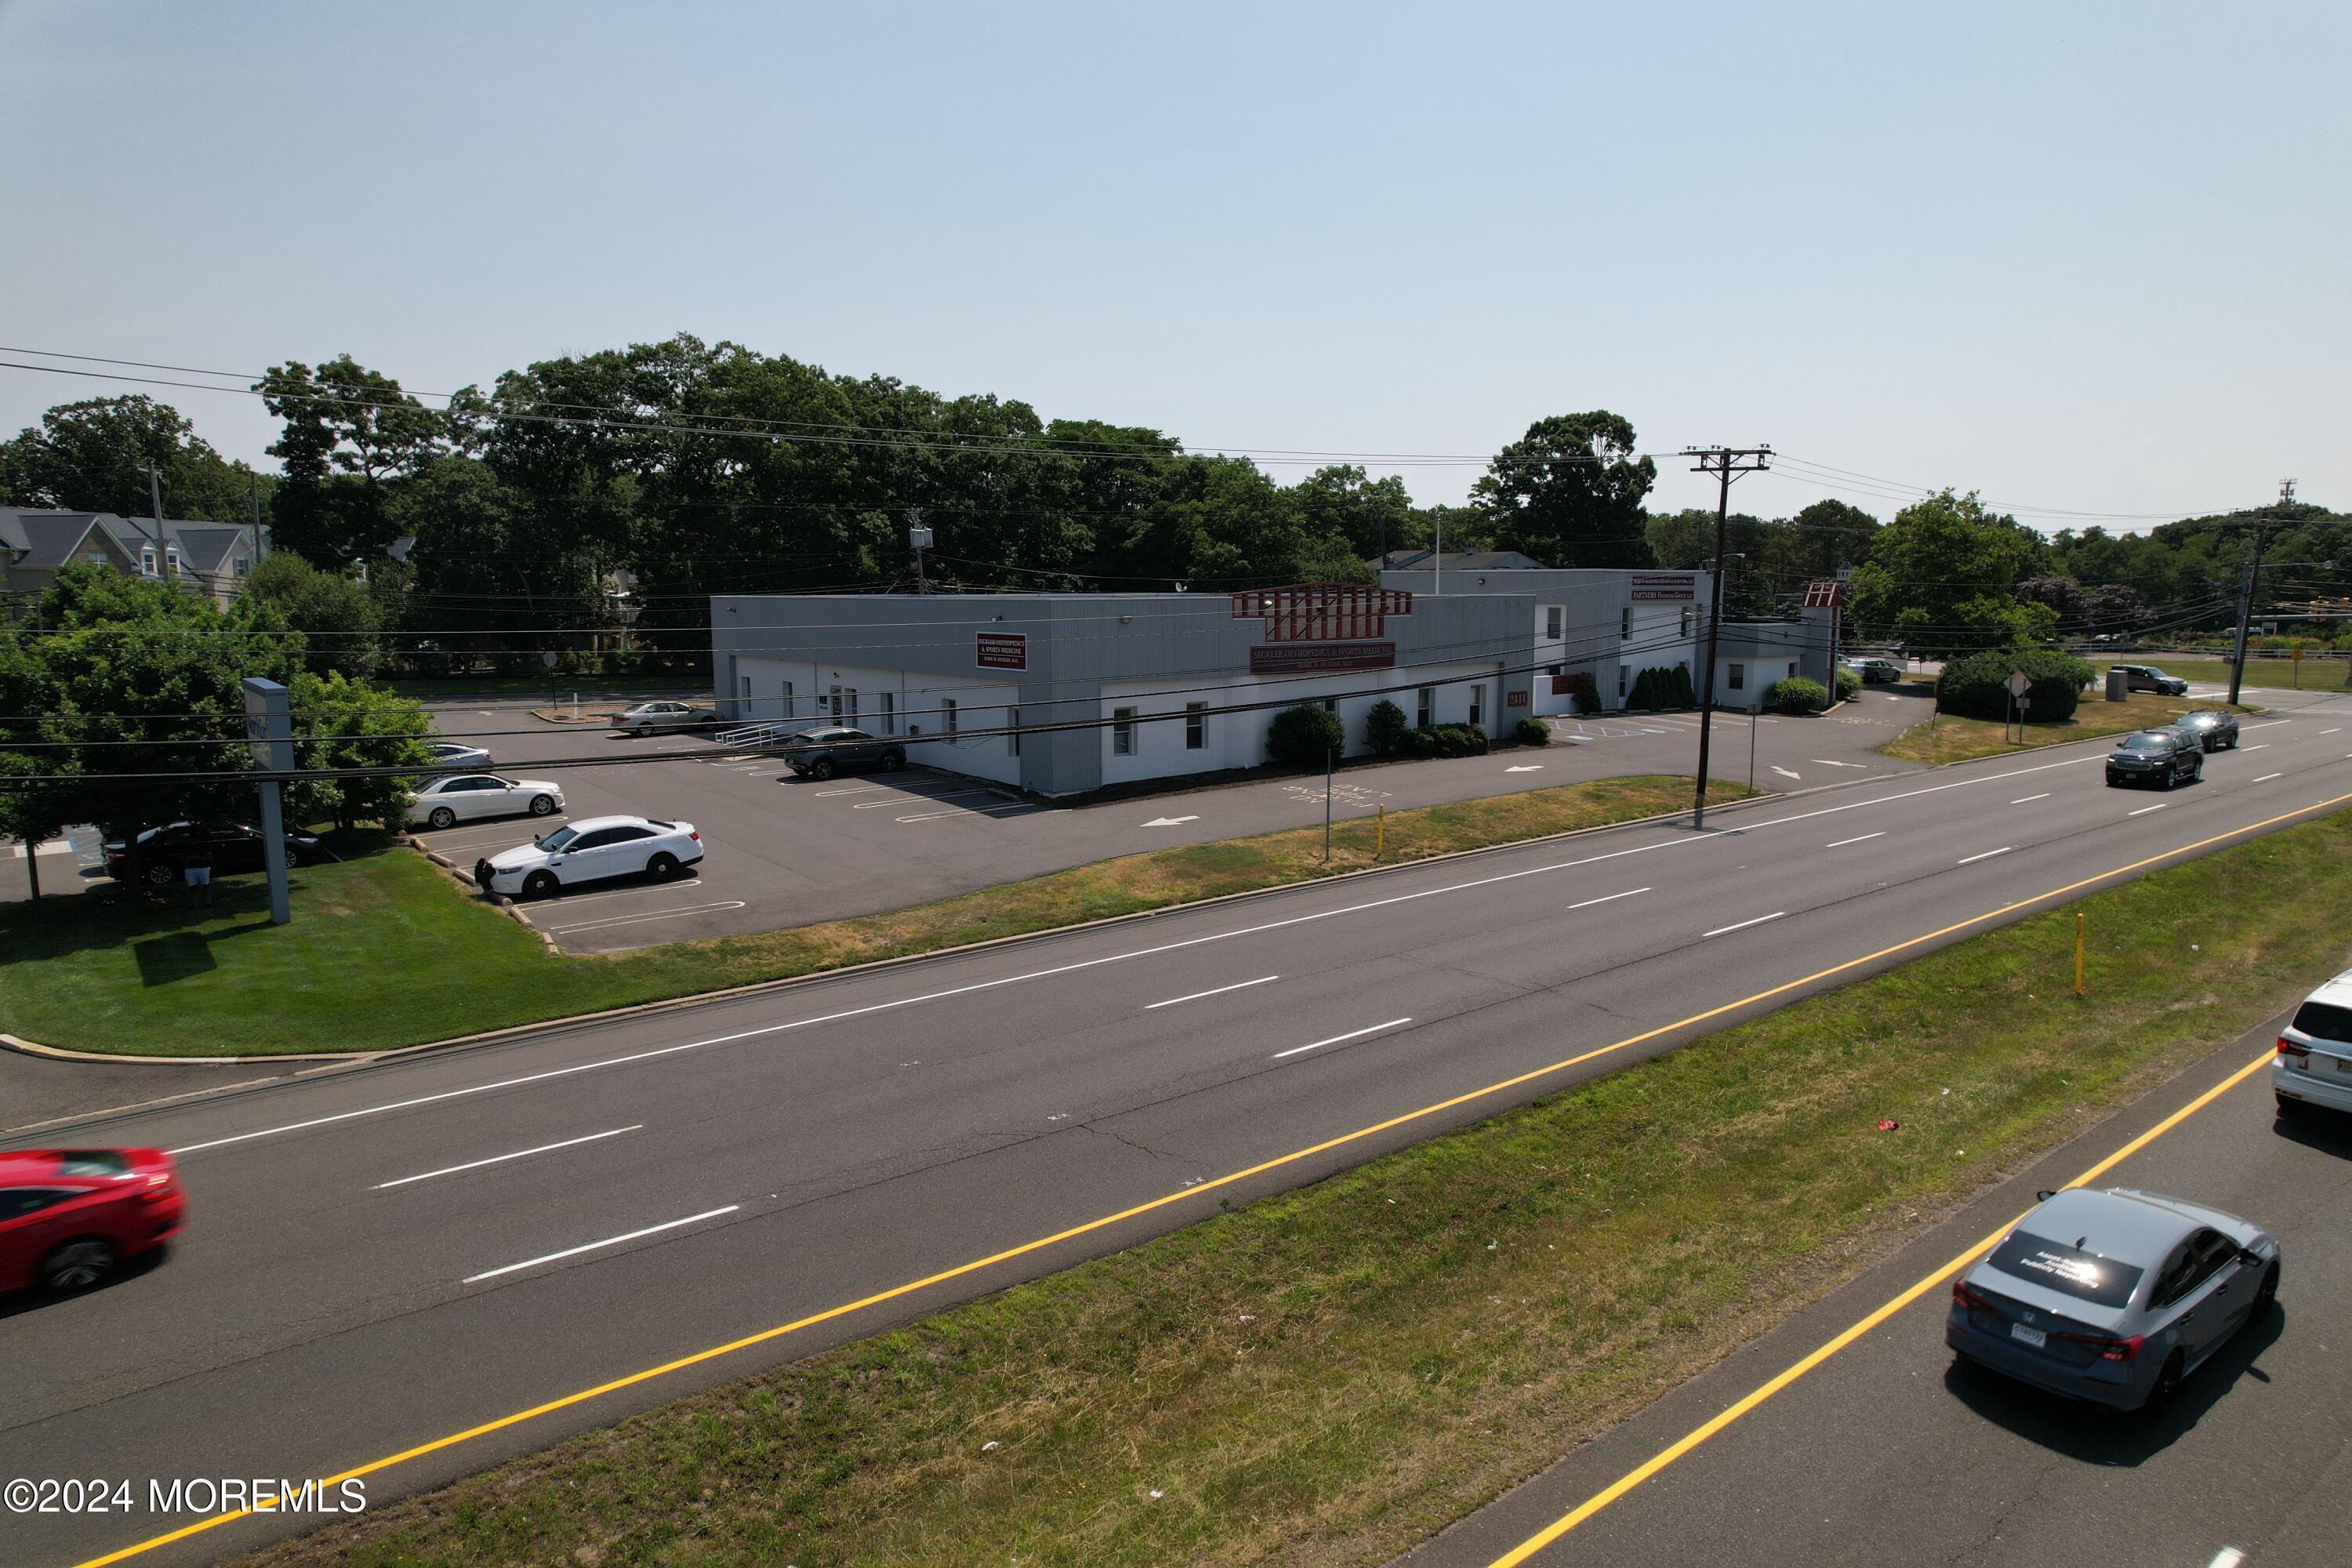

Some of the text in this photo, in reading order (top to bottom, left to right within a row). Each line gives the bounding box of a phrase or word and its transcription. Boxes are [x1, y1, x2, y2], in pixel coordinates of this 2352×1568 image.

[1338, 647, 1361, 655] SPORTS
[1363, 645, 1393, 655] MEDICINE
[2020, 1258, 2056, 1273] Publicly
